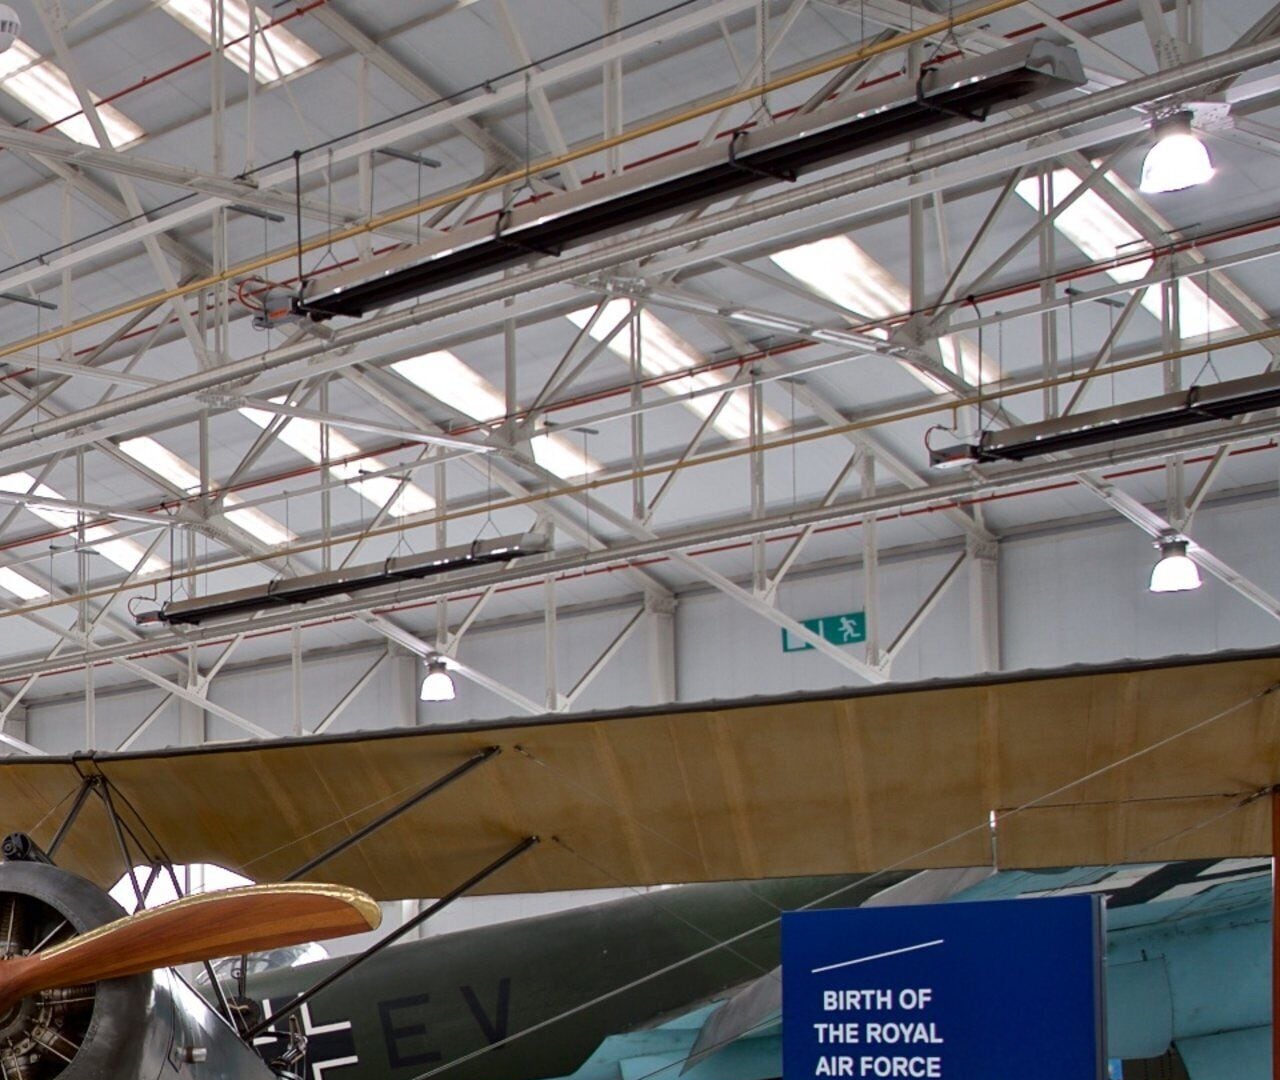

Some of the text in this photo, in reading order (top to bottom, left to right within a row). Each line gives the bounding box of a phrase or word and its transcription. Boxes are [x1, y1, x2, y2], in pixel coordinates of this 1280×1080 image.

[824, 988, 932, 1010] BIRTH OF
[813, 1022, 944, 1043] THE ROYAL
[815, 1056, 941, 1077] AIR FORCE
